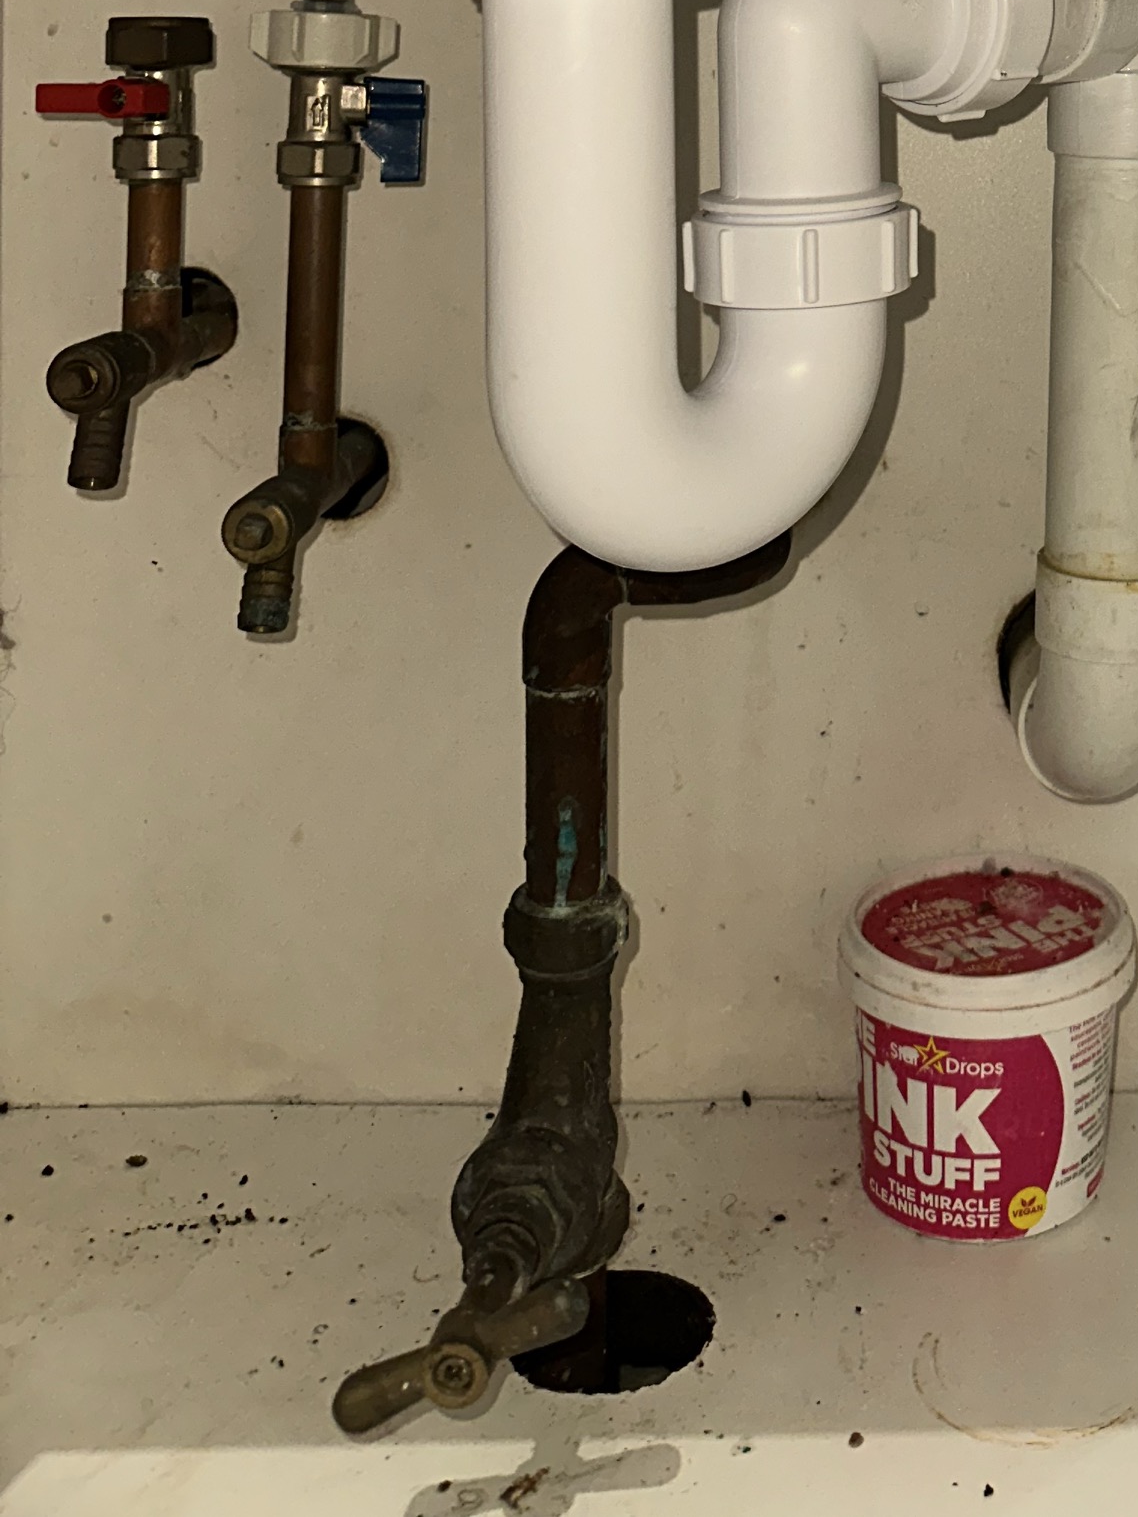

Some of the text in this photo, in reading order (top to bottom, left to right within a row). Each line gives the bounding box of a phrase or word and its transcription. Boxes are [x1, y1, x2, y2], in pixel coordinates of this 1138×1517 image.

[945, 1057, 1005, 1079] Drops
[873, 1129, 1001, 1191] STUFF
[869, 1177, 1001, 1228] CLEANING PASTE
[888, 1177, 1001, 1213] THE MIRACLE
[1012, 1204, 1044, 1218] VEGAN
